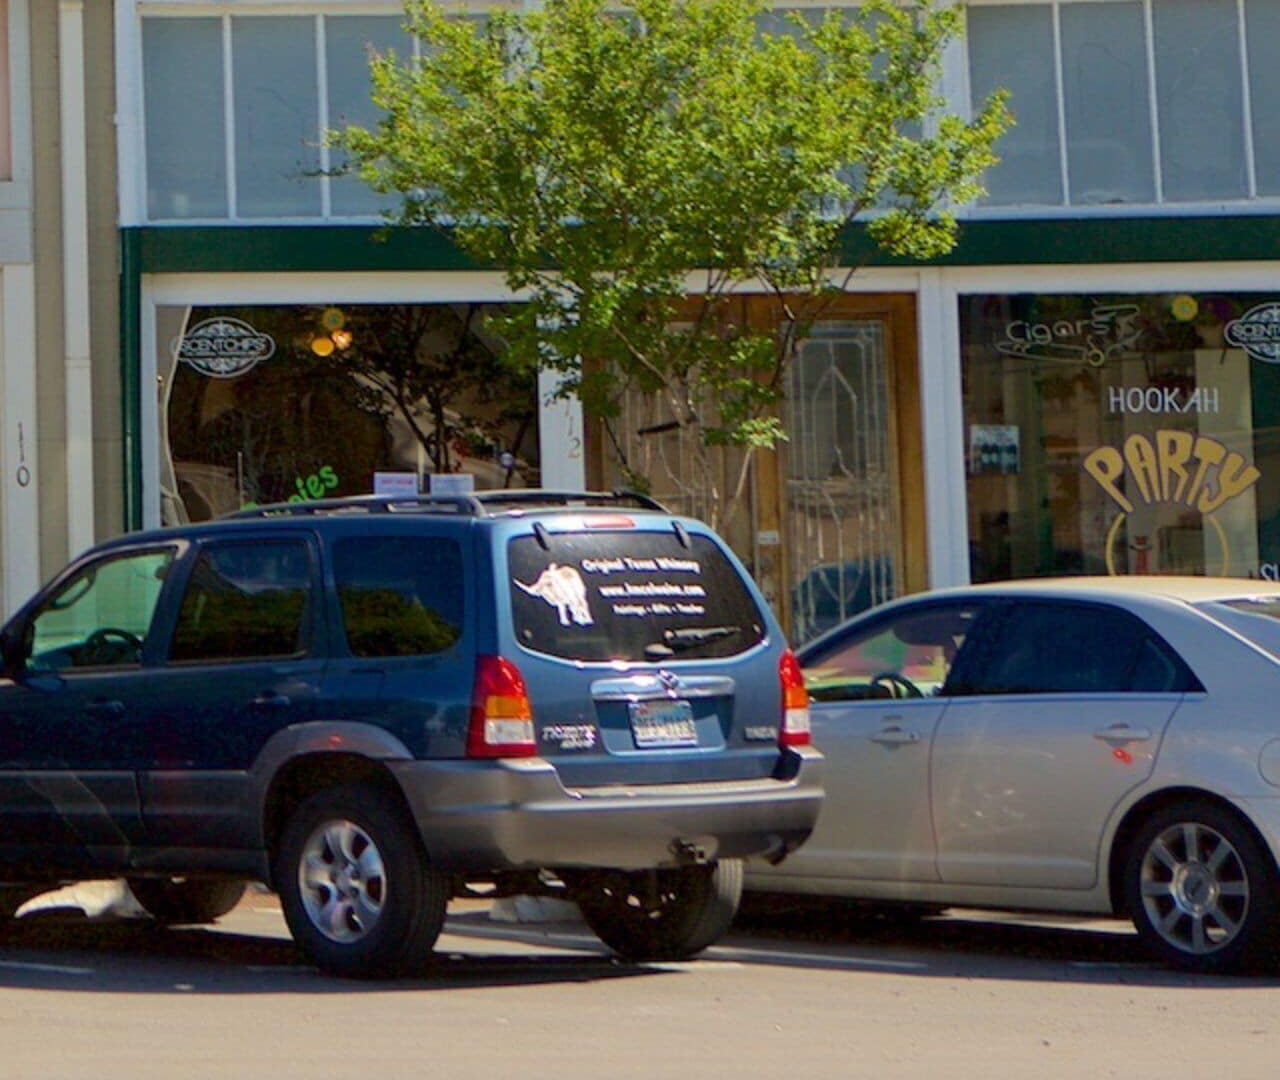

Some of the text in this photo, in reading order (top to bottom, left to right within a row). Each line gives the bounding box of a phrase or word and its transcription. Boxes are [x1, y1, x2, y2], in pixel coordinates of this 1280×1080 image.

[1006, 319, 1111, 345] Cigars
[1109, 386, 1220, 414] HOOKAH
[1083, 429, 1262, 515] PARTY
